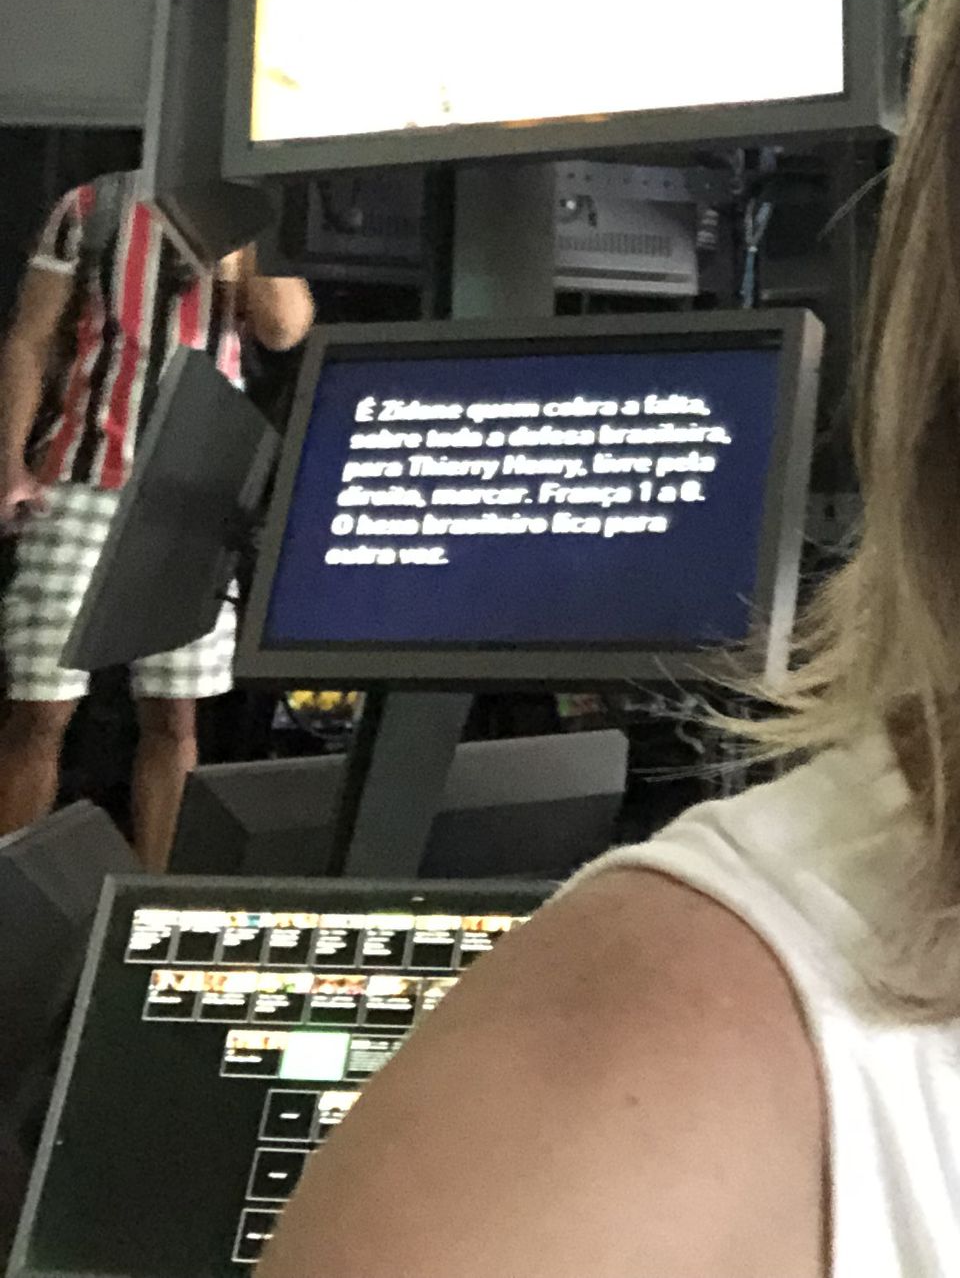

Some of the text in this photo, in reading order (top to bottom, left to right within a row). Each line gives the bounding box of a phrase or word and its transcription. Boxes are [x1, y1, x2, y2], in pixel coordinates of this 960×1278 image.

[378, 399, 464, 422] Zidane
[466, 401, 540, 424] quem
[543, 395, 618, 418] cobra
[620, 400, 641, 416] a
[350, 428, 423, 450] sobre
[426, 426, 485, 448] toda
[485, 430, 507, 448] a
[507, 424, 597, 447] defesa
[342, 450, 716, 483] para Thierry Henry, livre pela
[430, 486, 534, 506] marcar.
[538, 480, 633, 508] França
[638, 480, 653, 503] 1
[656, 485, 679, 503] a
[331, 513, 356, 536] O
[422, 512, 549, 535] brasileiro
[550, 511, 602, 534] fica
[603, 514, 668, 538] para
[325, 545, 398, 566] outra
